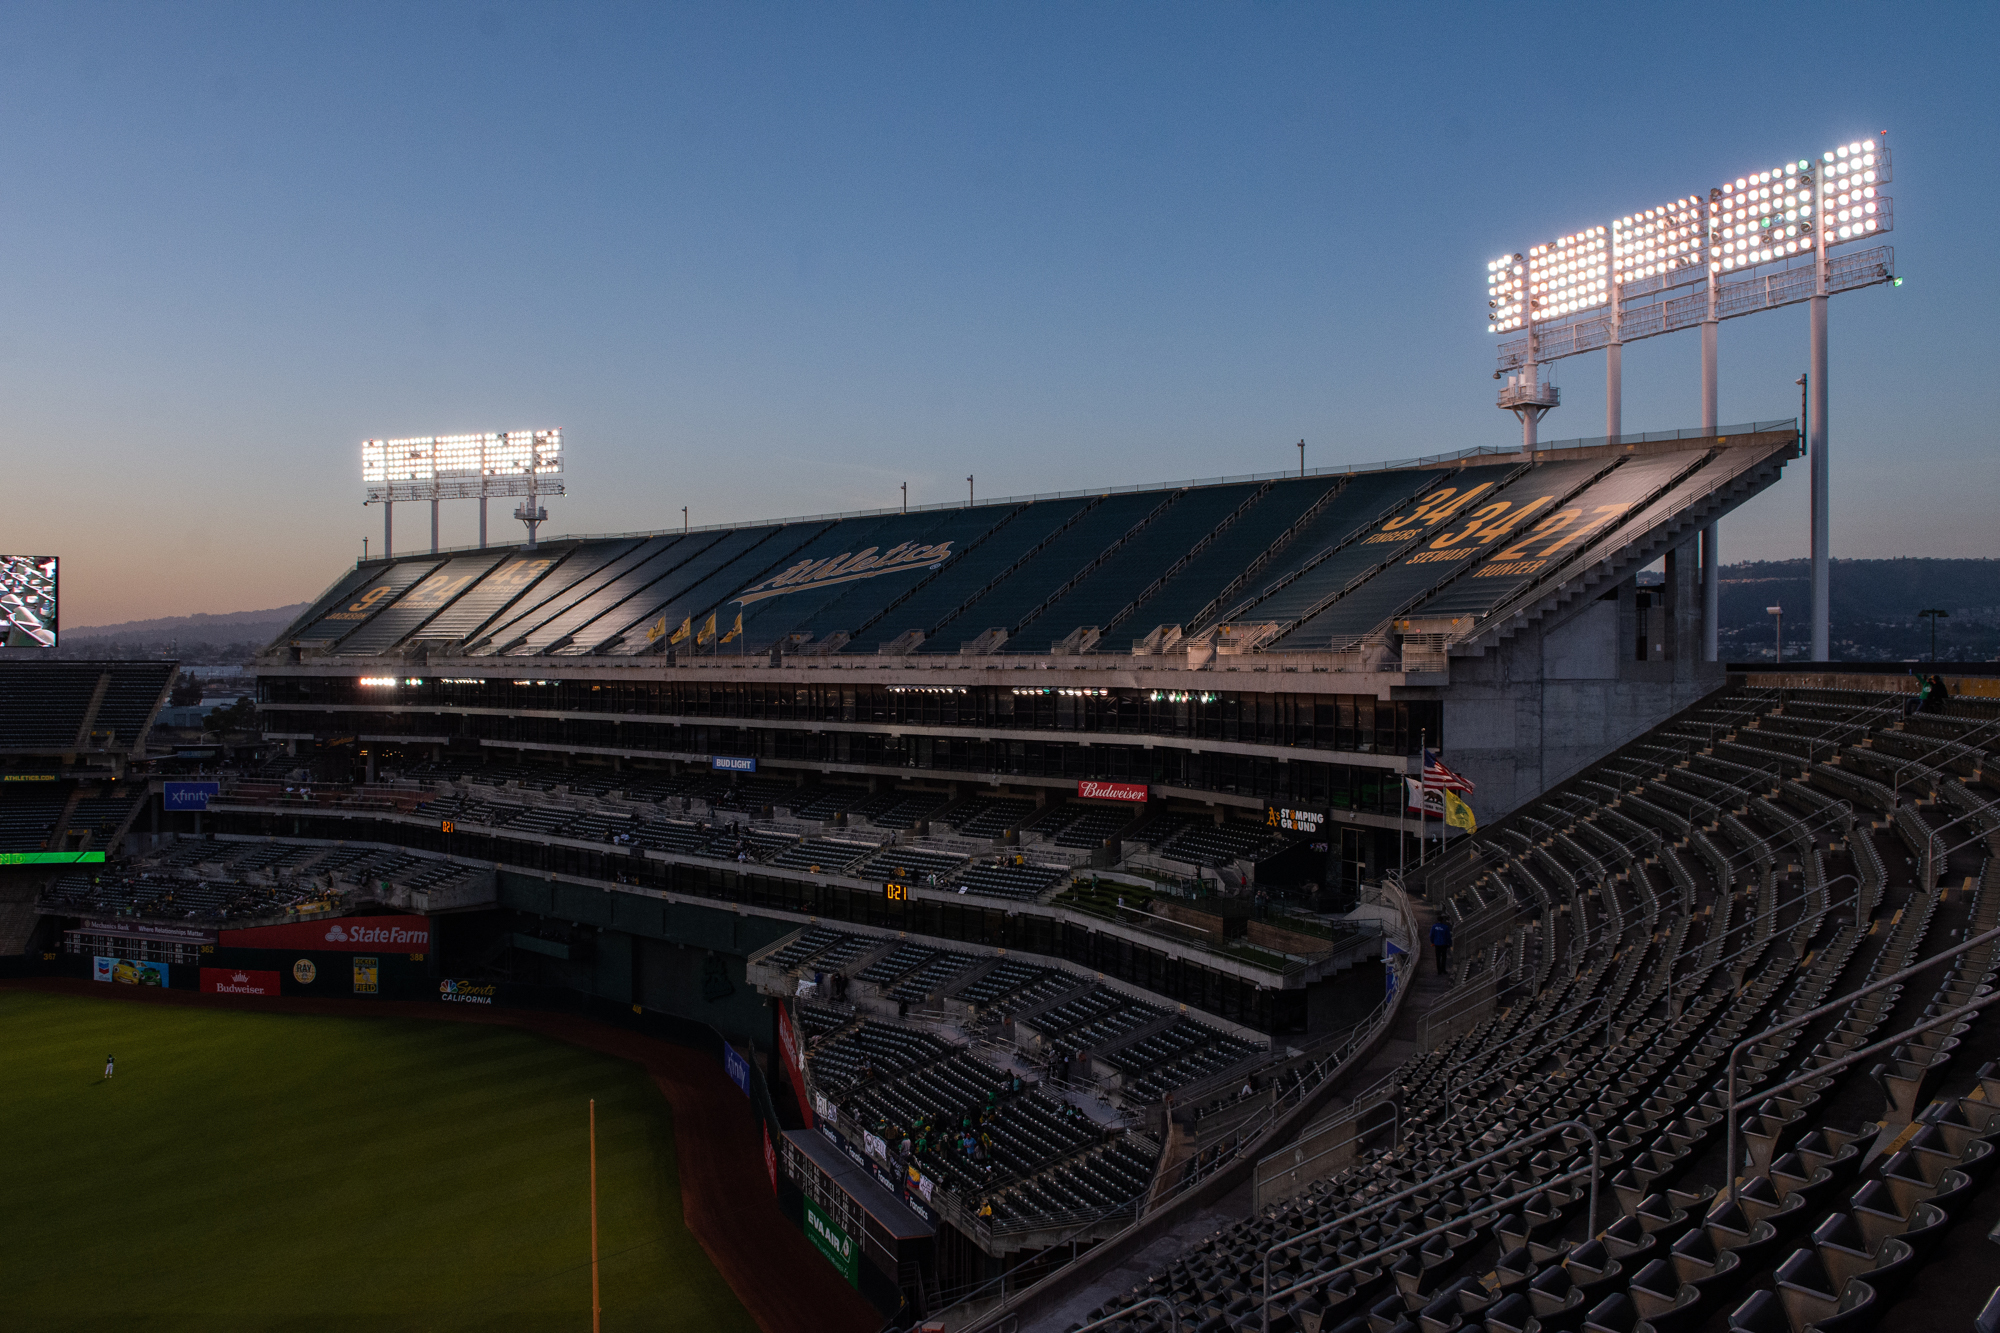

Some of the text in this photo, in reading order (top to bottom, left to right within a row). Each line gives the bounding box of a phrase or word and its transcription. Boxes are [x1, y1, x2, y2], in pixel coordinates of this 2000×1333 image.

[1382, 481, 1495, 530] 34
[1430, 496, 1554, 549] 34
[1361, 528, 1422, 545] FINGERS
[1490, 502, 1634, 561] 27
[1406, 547, 1480, 564] STEWART
[489, 559, 550, 584] 43
[735, 541, 954, 598] Athletics
[1472, 560, 1547, 578] HUNTER
[405, 575, 473, 601] 24
[348, 586, 391, 612] 9
[716, 758, 751, 770] BUD LIGHT
[172, 789, 209, 804] xfinity
[1081, 781, 1145, 800] Budweiser
[887, 884, 907, 901] 0:21
[91, 921, 130, 931] Mechanics Bank
[138, 925, 204, 937] Where Relationships Matter
[410, 953, 424, 961] 388
[296, 964, 312, 972] RAY
[216, 983, 265, 995] Budweiser
[355, 984, 376, 992] FIELD
[456, 980, 496, 995] Sports
[441, 993, 492, 1004] CALIFORNIA
[878, 1169, 894, 1192] Fanatics
[909, 1196, 928, 1221] Fanatics
[807, 1209, 825, 1237] EVA
[825, 1227, 840, 1253] AIR
